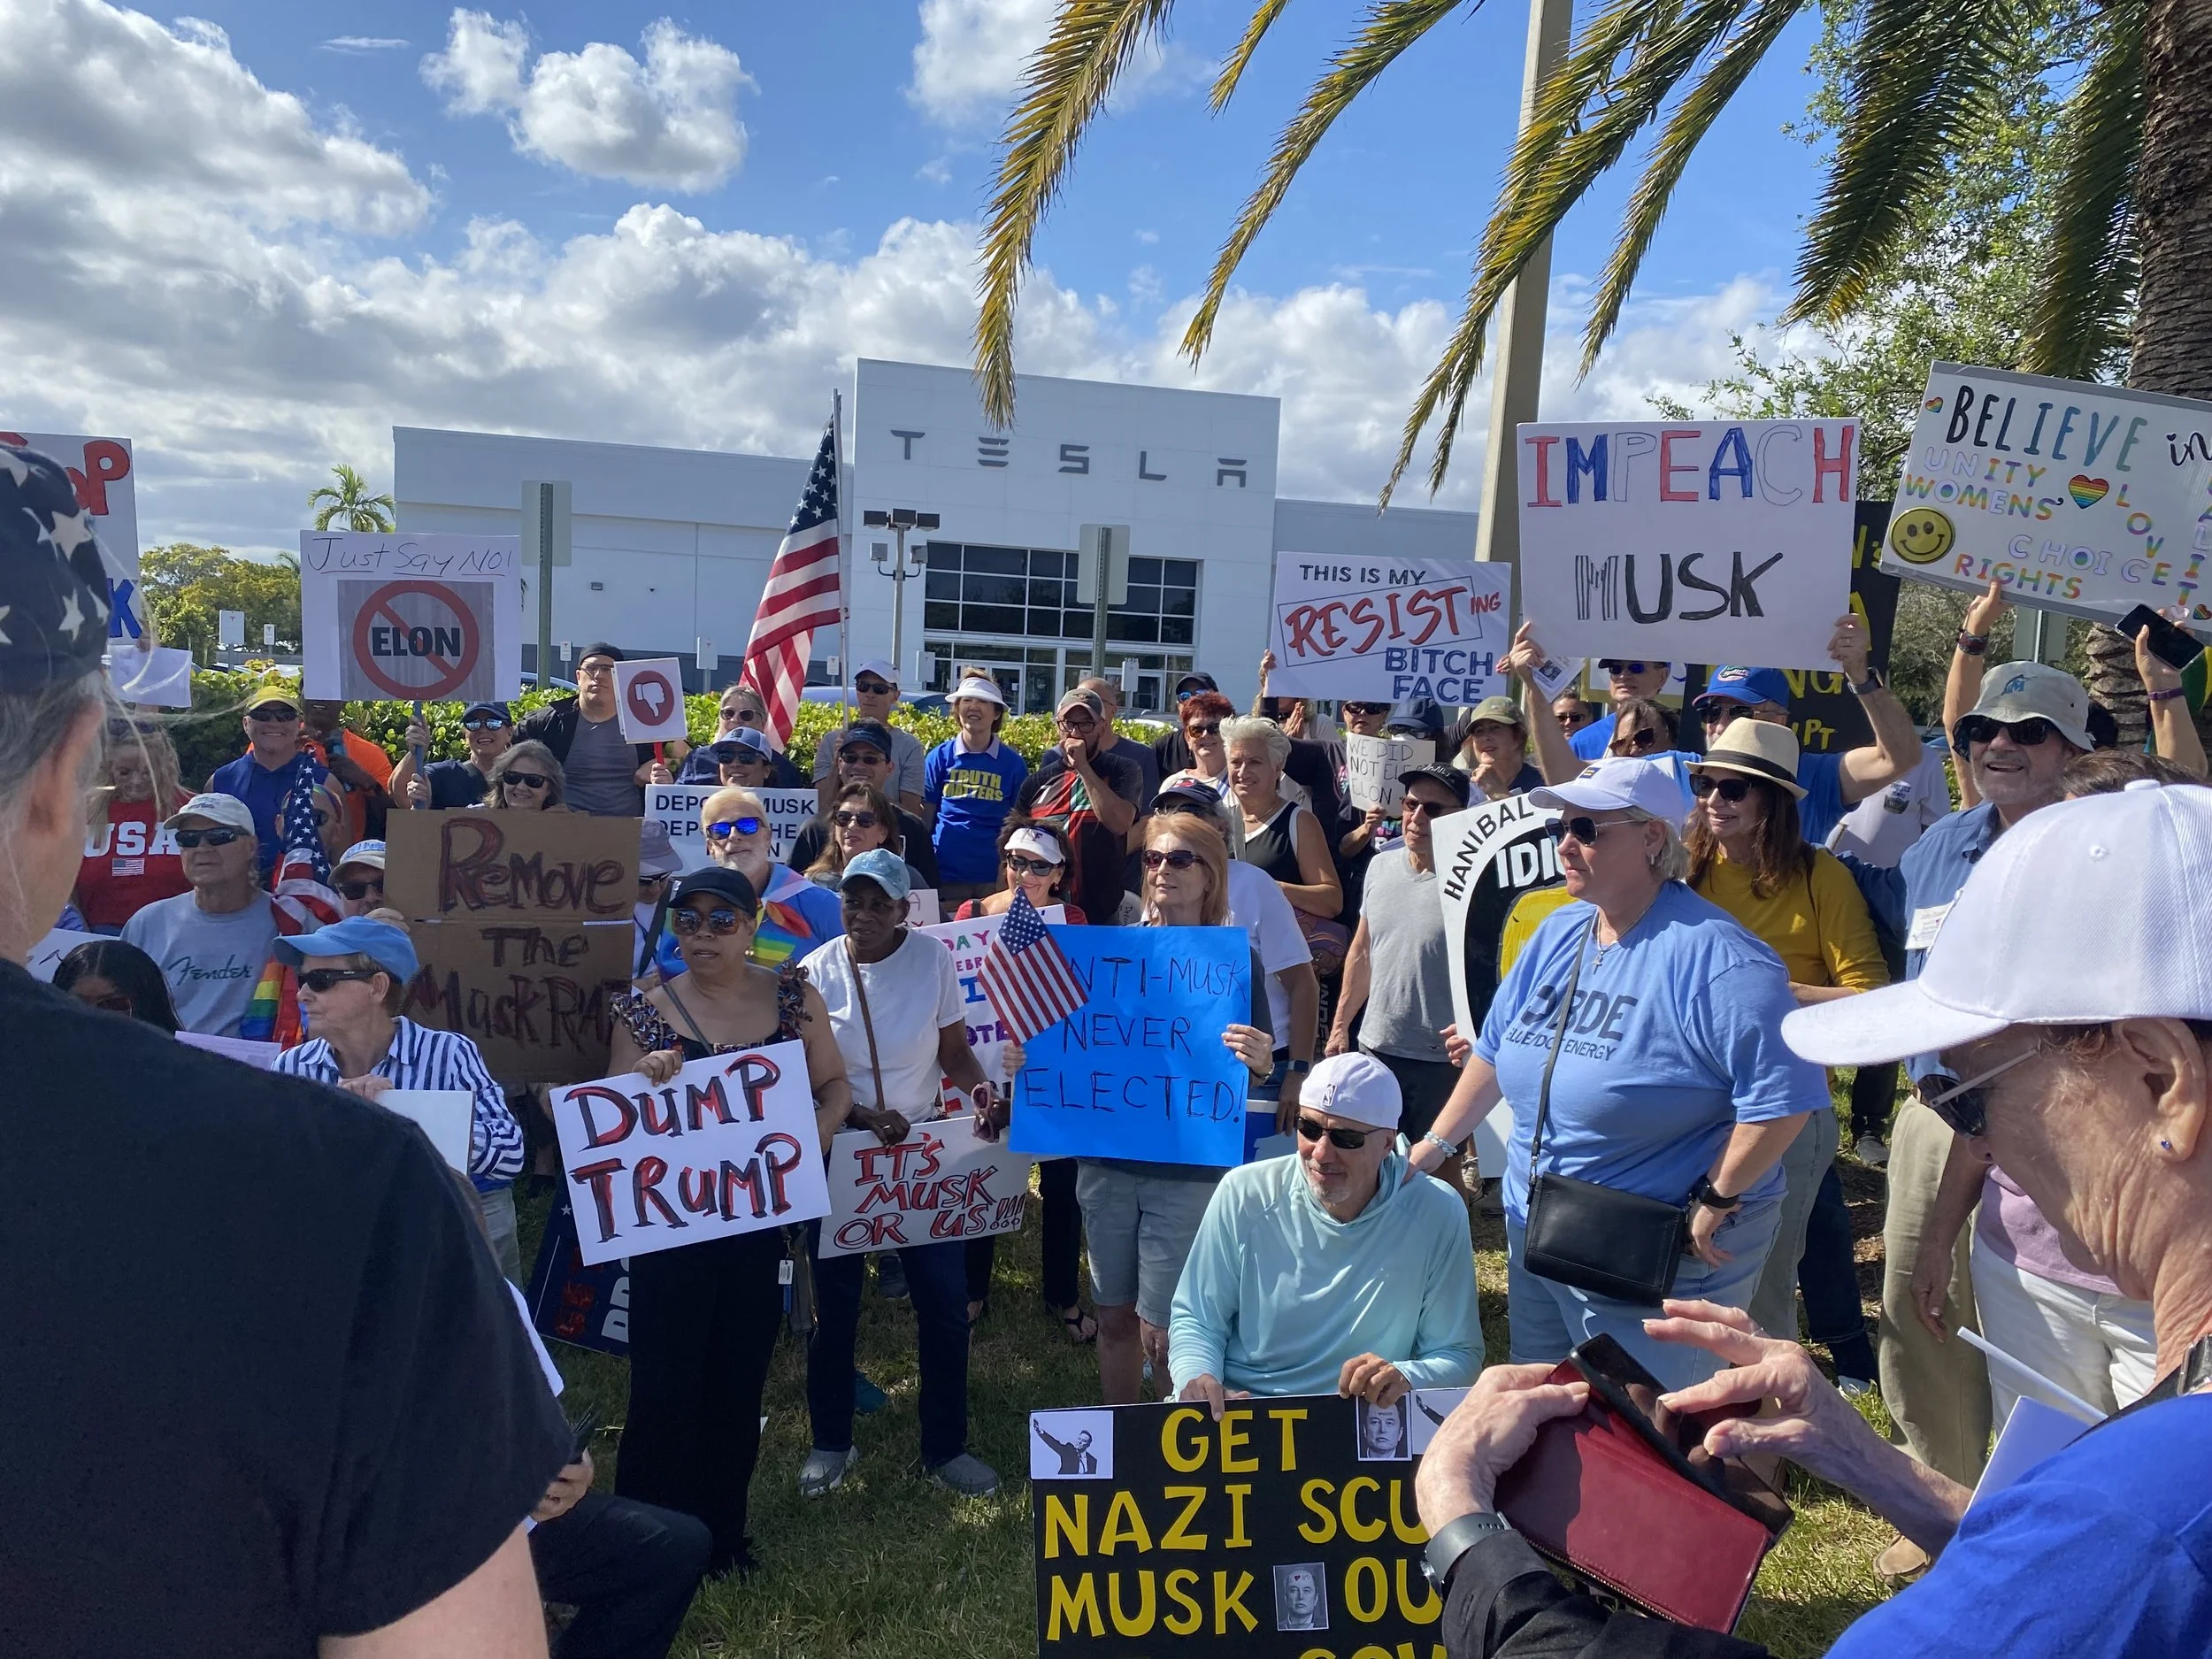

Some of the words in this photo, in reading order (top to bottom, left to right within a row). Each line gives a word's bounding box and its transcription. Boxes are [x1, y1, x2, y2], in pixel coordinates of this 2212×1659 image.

[1946, 385, 2148, 472] BELIEVE
[2166, 432, 2212, 466] in
[890, 429, 1248, 488] TESLA
[1525, 425, 1855, 507] IMPEACH
[1924, 446, 2047, 488] UNITY
[308, 537, 390, 571] Just
[394, 542, 455, 576] Say
[458, 549, 512, 574] NO!
[2116, 483, 2172, 586] LOVE
[1299, 565, 1352, 582] THIS
[1360, 567, 1380, 584] IS
[1388, 569, 1426, 586] MY
[1574, 551, 1784, 625] MUSK
[1954, 553, 2083, 600] RIGHTS
[372, 626, 461, 657] ELON
[1385, 647, 1494, 676] BITCH
[1392, 675, 1485, 703] FACE
[1349, 740, 1370, 757] WE
[1377, 742, 1414, 762] DID
[1350, 757, 1379, 777] NOT
[942, 784, 1004, 801] MATTERS
[949, 770, 1002, 789] TRUTH
[1352, 779, 1393, 805] ELON
[83, 821, 181, 857] USA
[1443, 796, 1534, 902] HANIBAL
[167, 954, 253, 987] Fender
[1071, 956, 1247, 1002] NTI-MUSK
[1063, 1013, 1192, 1056] NEVER
[1563, 1039, 1617, 1062] ENERGY
[563, 1054, 781, 1152] DUMP
[1023, 1067, 1247, 1124] ELECTED!
[854, 1132, 945, 1187] IT'S
[569, 1133, 803, 1244] TRUMP
[855, 1165, 999, 1214] MUSK
[833, 1212, 910, 1249] OR
[1161, 1408, 1308, 1474] GET
[1044, 1483, 1252, 1560] NAZI
[1297, 1477, 1430, 1545] SCU
[1047, 1569, 1259, 1641] MUSK
